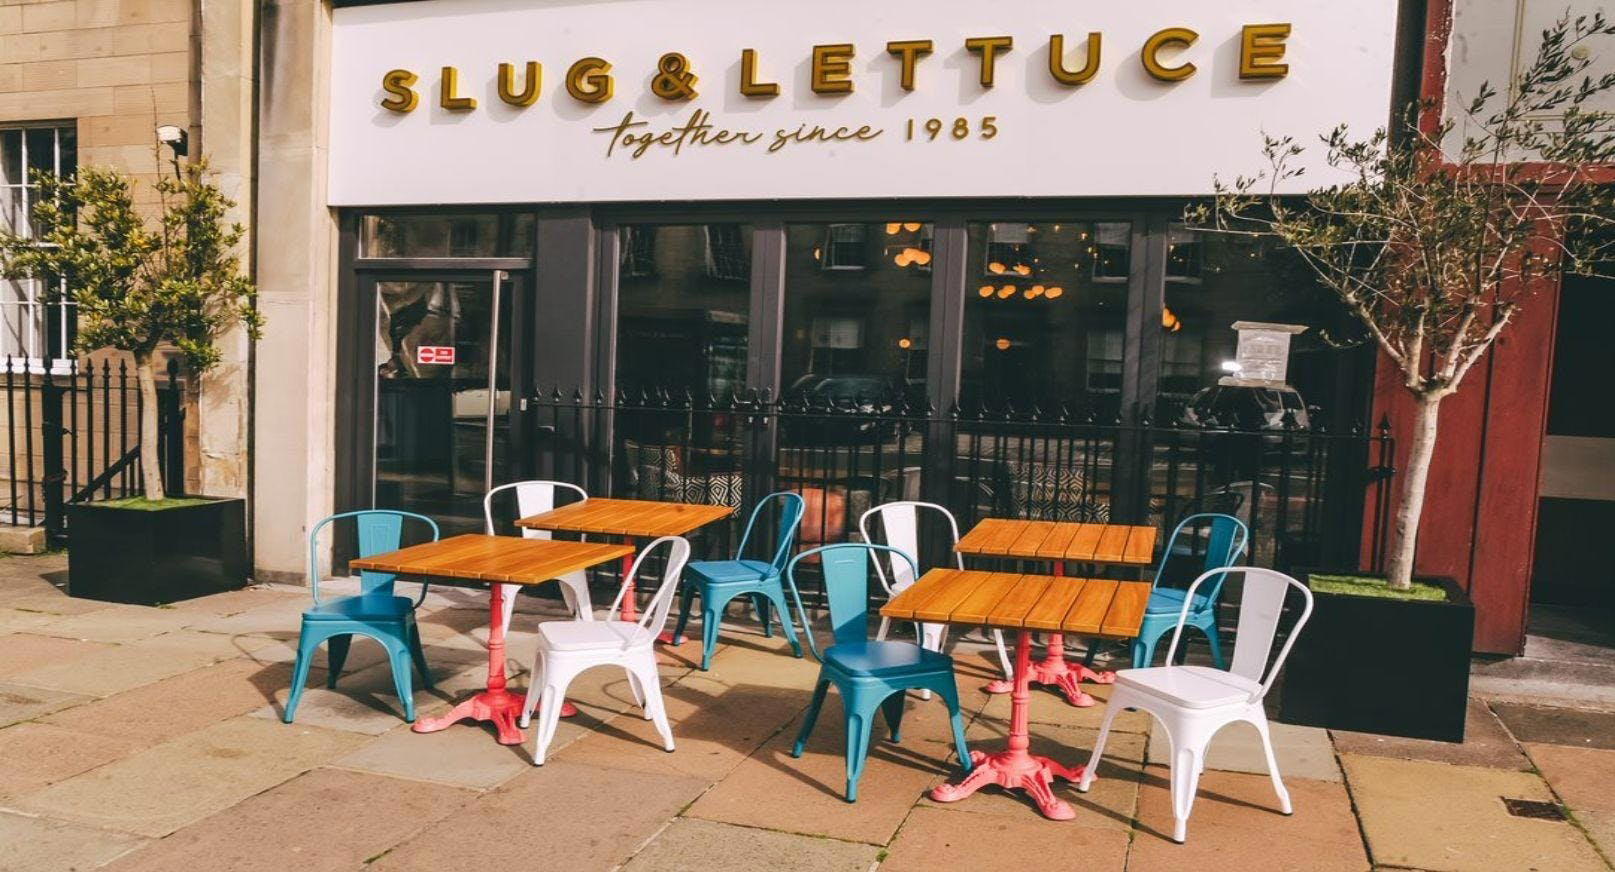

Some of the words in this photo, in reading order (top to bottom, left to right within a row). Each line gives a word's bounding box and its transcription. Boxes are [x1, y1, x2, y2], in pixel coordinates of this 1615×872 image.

[381, 56, 614, 113] SLUG
[651, 52, 699, 101] &
[740, 23, 1292, 97] LETTUCE
[593, 108, 763, 159] together
[767, 122, 884, 153] since
[905, 116, 1000, 143] 1985
